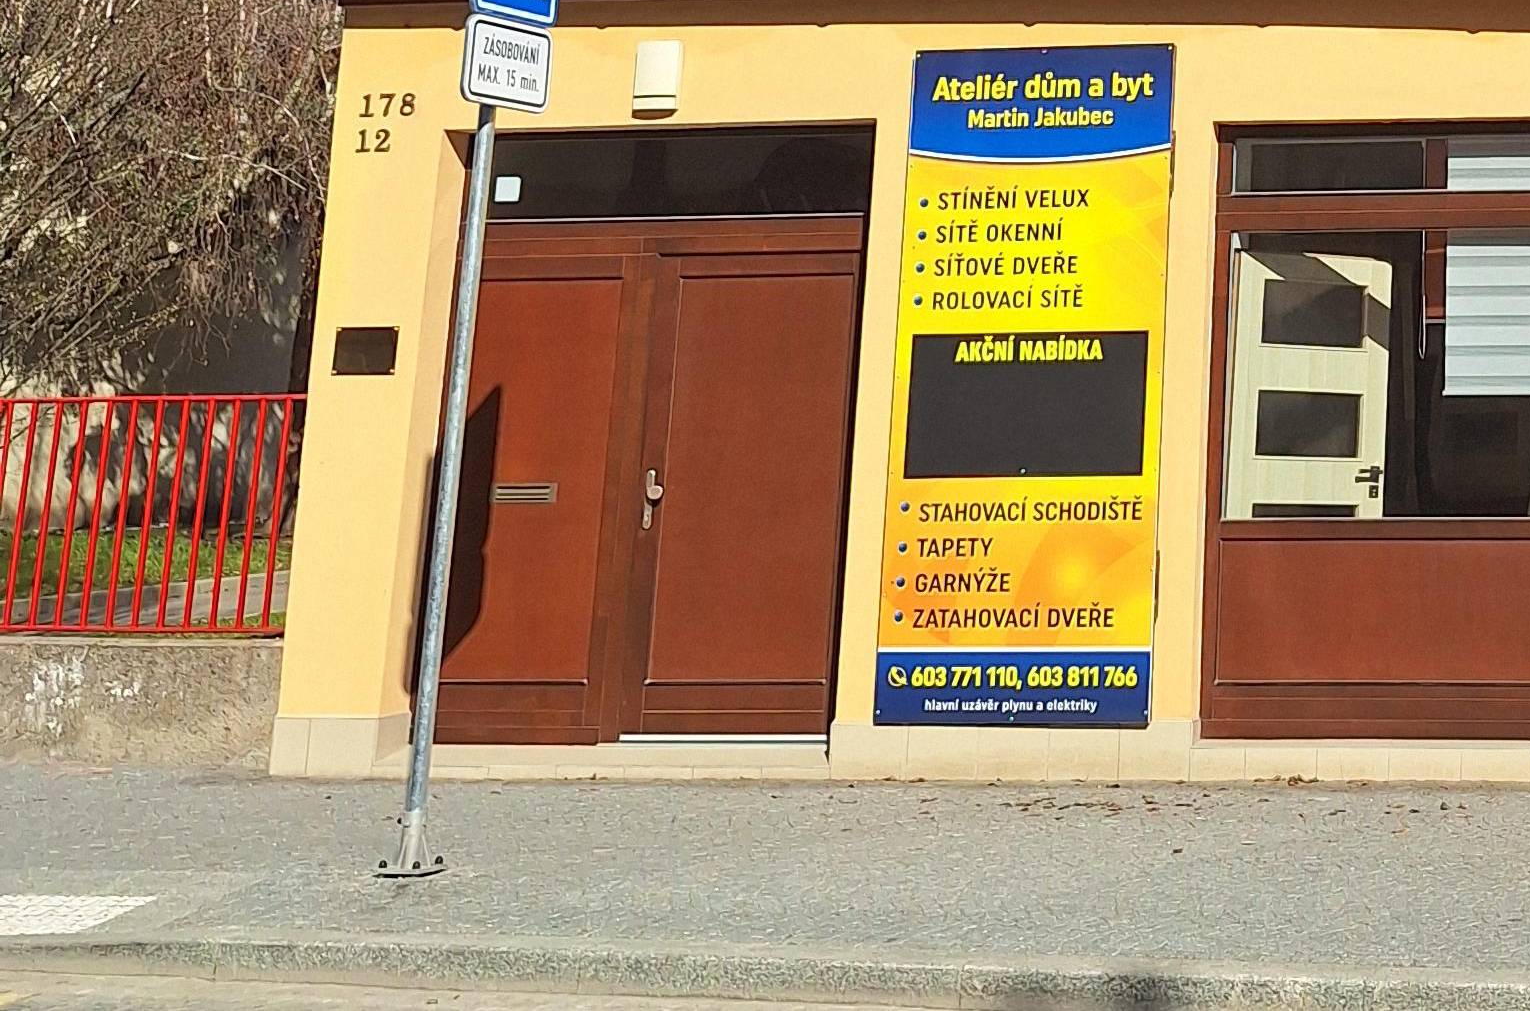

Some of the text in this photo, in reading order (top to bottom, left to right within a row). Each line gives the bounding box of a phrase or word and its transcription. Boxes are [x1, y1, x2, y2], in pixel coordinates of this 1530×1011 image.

[483, 32, 541, 66] ZÁSOBOVÁNÍ
[477, 63, 539, 92] MAX. 15 min.
[932, 71, 1154, 102] Ateliér dům a byt
[358, 93, 416, 118] 178
[967, 107, 1114, 129] Martin Jakubec
[354, 129, 391, 153] 12
[938, 185, 1090, 211] STÍNĚNÍ VELUX
[936, 218, 1062, 244] SÍTĚ OKENNÍ
[934, 251, 1078, 277] SÍŤOVÉ DVEŘE
[932, 284, 1084, 310] ROLOVACÍ SÍTĚ
[955, 335, 1103, 363] AKČNÍ NABÍDKA
[918, 496, 1143, 523] STAHOVACÍ SCHODIŠTĚ
[917, 538, 994, 558] TAPETY
[915, 567, 1011, 593] GARNÝŽE
[912, 602, 1115, 629] ZATAHOVACÍ DVEŘE
[910, 666, 1138, 690] 603 771 110, 603 811 766
[924, 698, 1098, 714] hlavní uzávěr plynu a elektriky
